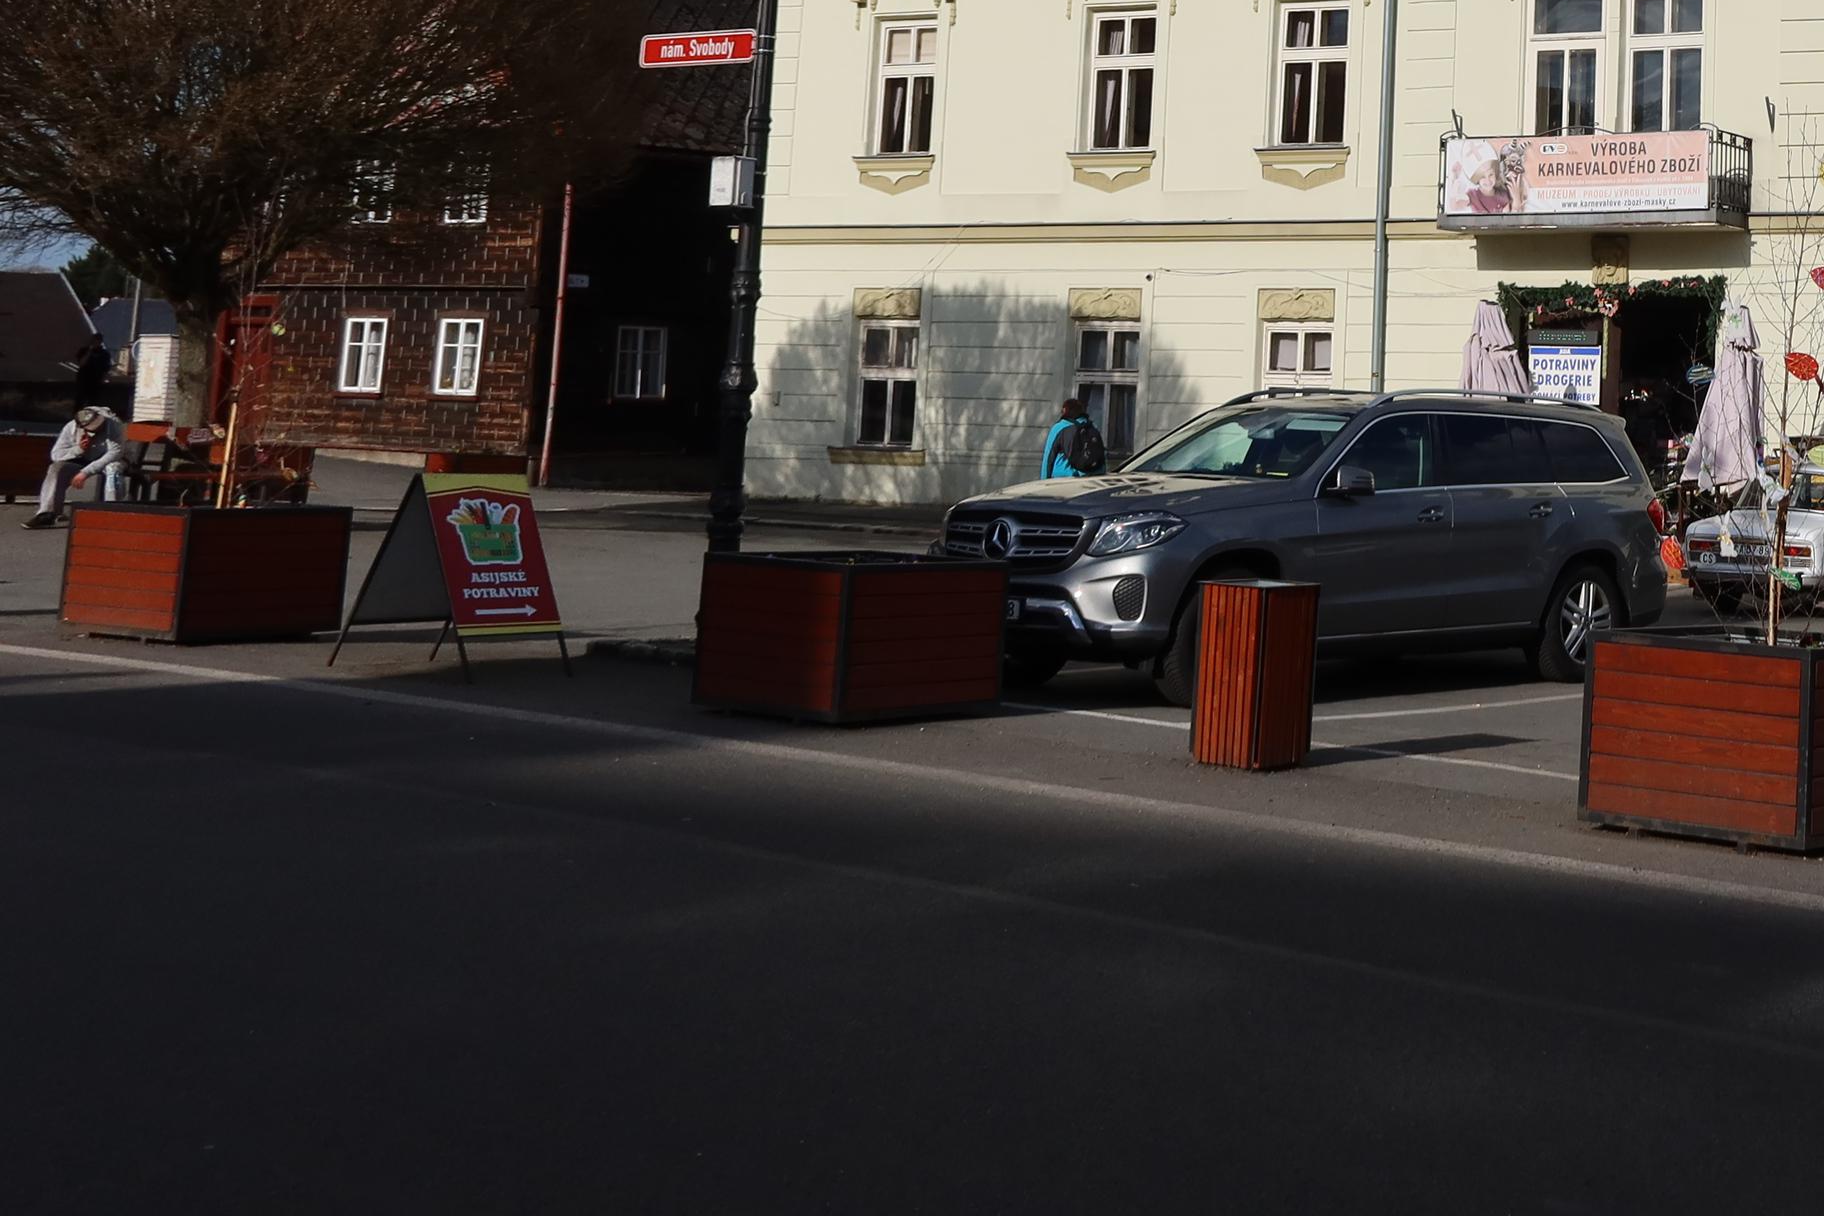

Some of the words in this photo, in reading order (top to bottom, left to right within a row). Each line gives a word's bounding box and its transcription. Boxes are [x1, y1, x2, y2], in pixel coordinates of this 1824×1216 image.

[660, 40, 686, 58] nám.
[689, 37, 735, 59] Svobody
[1591, 139, 1647, 156] VÝROBA
[1538, 157, 1656, 177] KARNEVALOVÉHO
[1660, 154, 1702, 173] ZBOŽÍ
[1537, 189, 1577, 200] MUZEUM
[1583, 189, 1612, 199] PRODEJ
[1533, 359, 1597, 371] POTRAVINY
[1537, 374, 1592, 386] DROGERIE
[1702, 553, 1713, 564] CS
[471, 569, 527, 584] ASIJSKÉ
[463, 586, 540, 599] POTRAVINY
